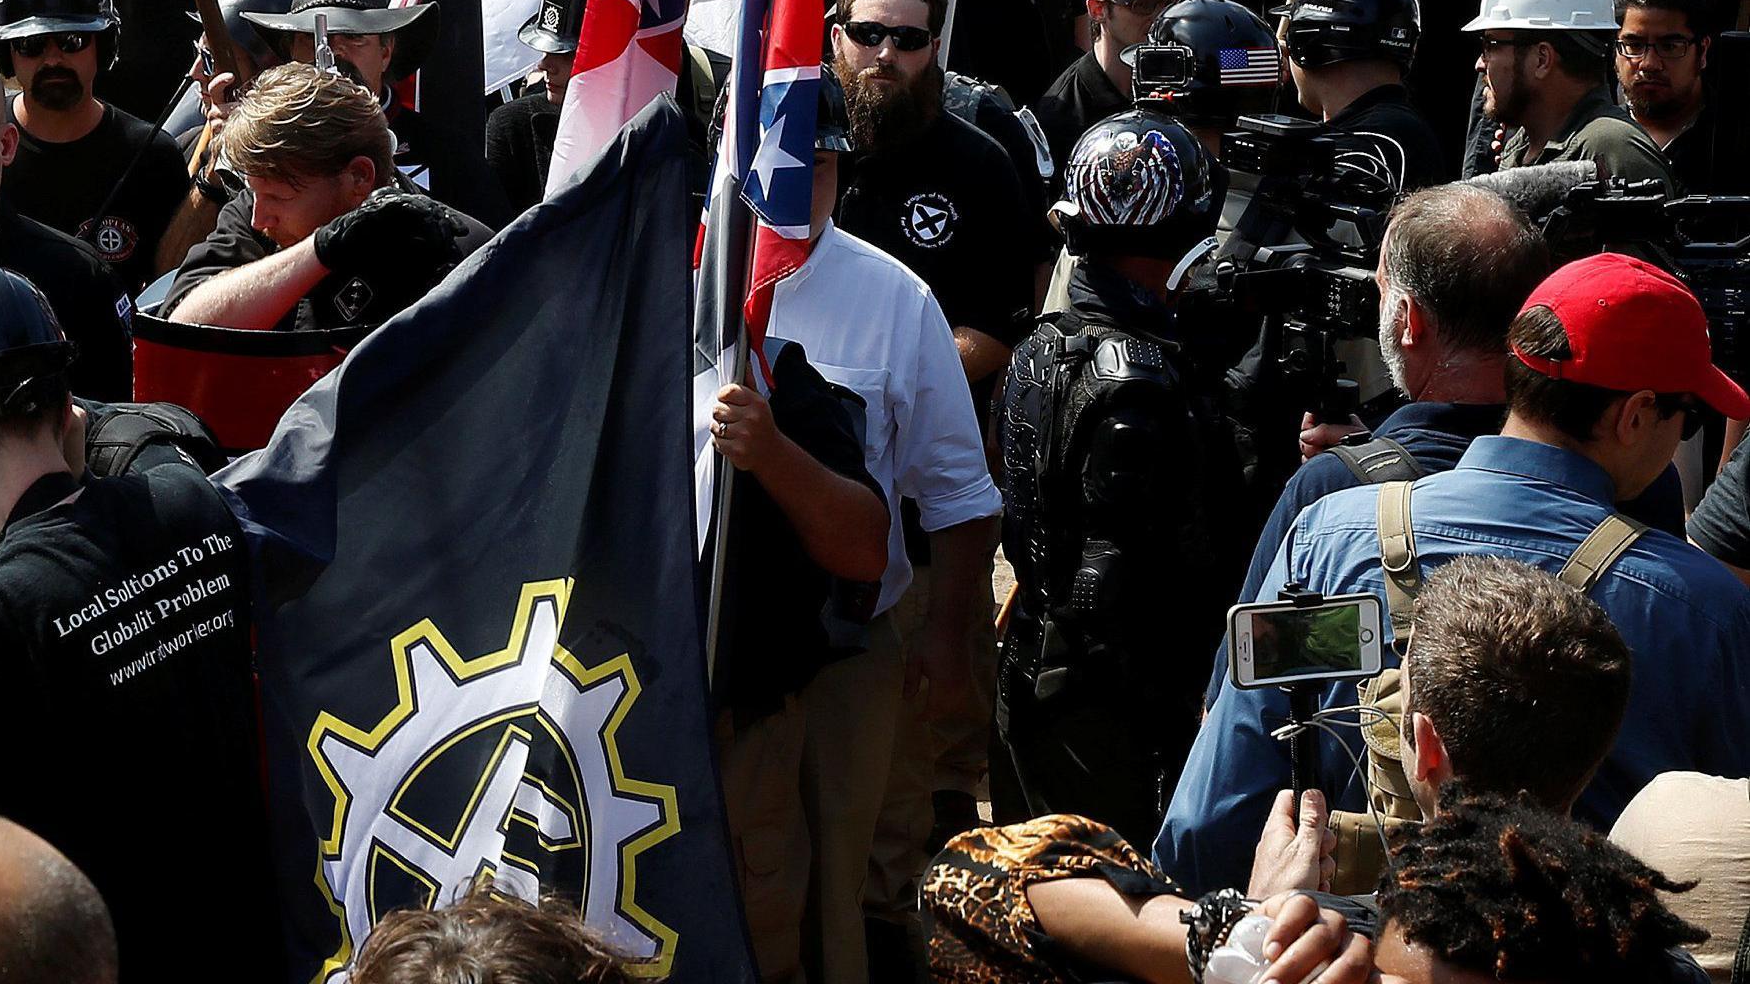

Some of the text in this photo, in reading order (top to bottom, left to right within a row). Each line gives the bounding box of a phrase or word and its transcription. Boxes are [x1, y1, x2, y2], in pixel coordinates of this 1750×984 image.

[53, 595, 108, 638] Local
[177, 547, 203, 567] To
[203, 534, 233, 556] The
[155, 574, 230, 619] Problem
